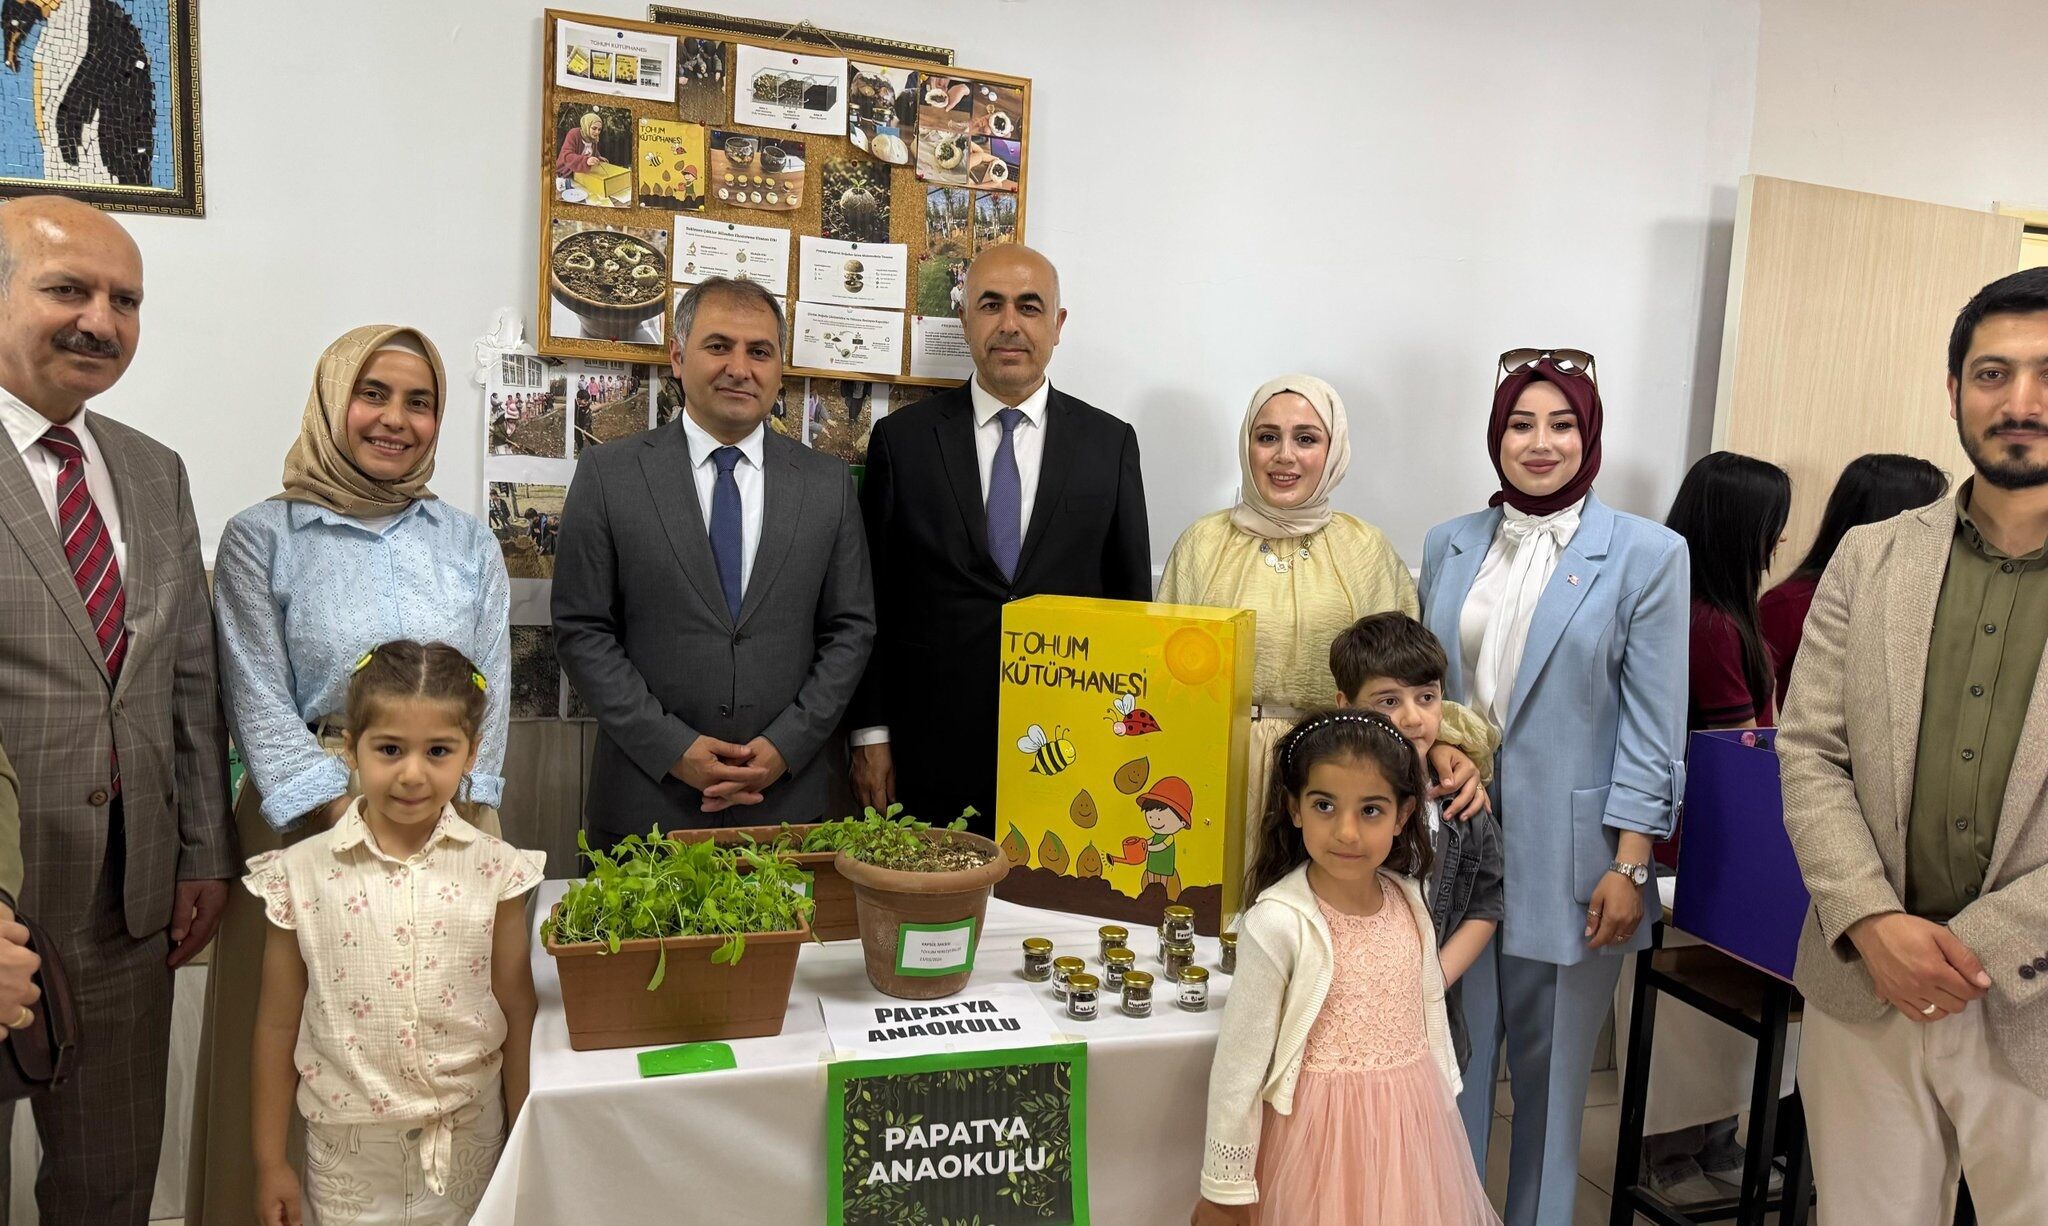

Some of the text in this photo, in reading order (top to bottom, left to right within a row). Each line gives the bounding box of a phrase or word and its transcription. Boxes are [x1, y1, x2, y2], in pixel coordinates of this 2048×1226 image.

[640, 125, 666, 135] TOHUM
[1004, 631, 1089, 661] TOHUM
[1002, 655, 1147, 699] KÜTÜPHANESİ
[874, 1000, 998, 1024] PAPATYA
[868, 1018, 1021, 1042] ANAOKULU
[885, 1116, 1031, 1152] PAPATYA
[866, 1146, 1046, 1185] ANAOKULU
